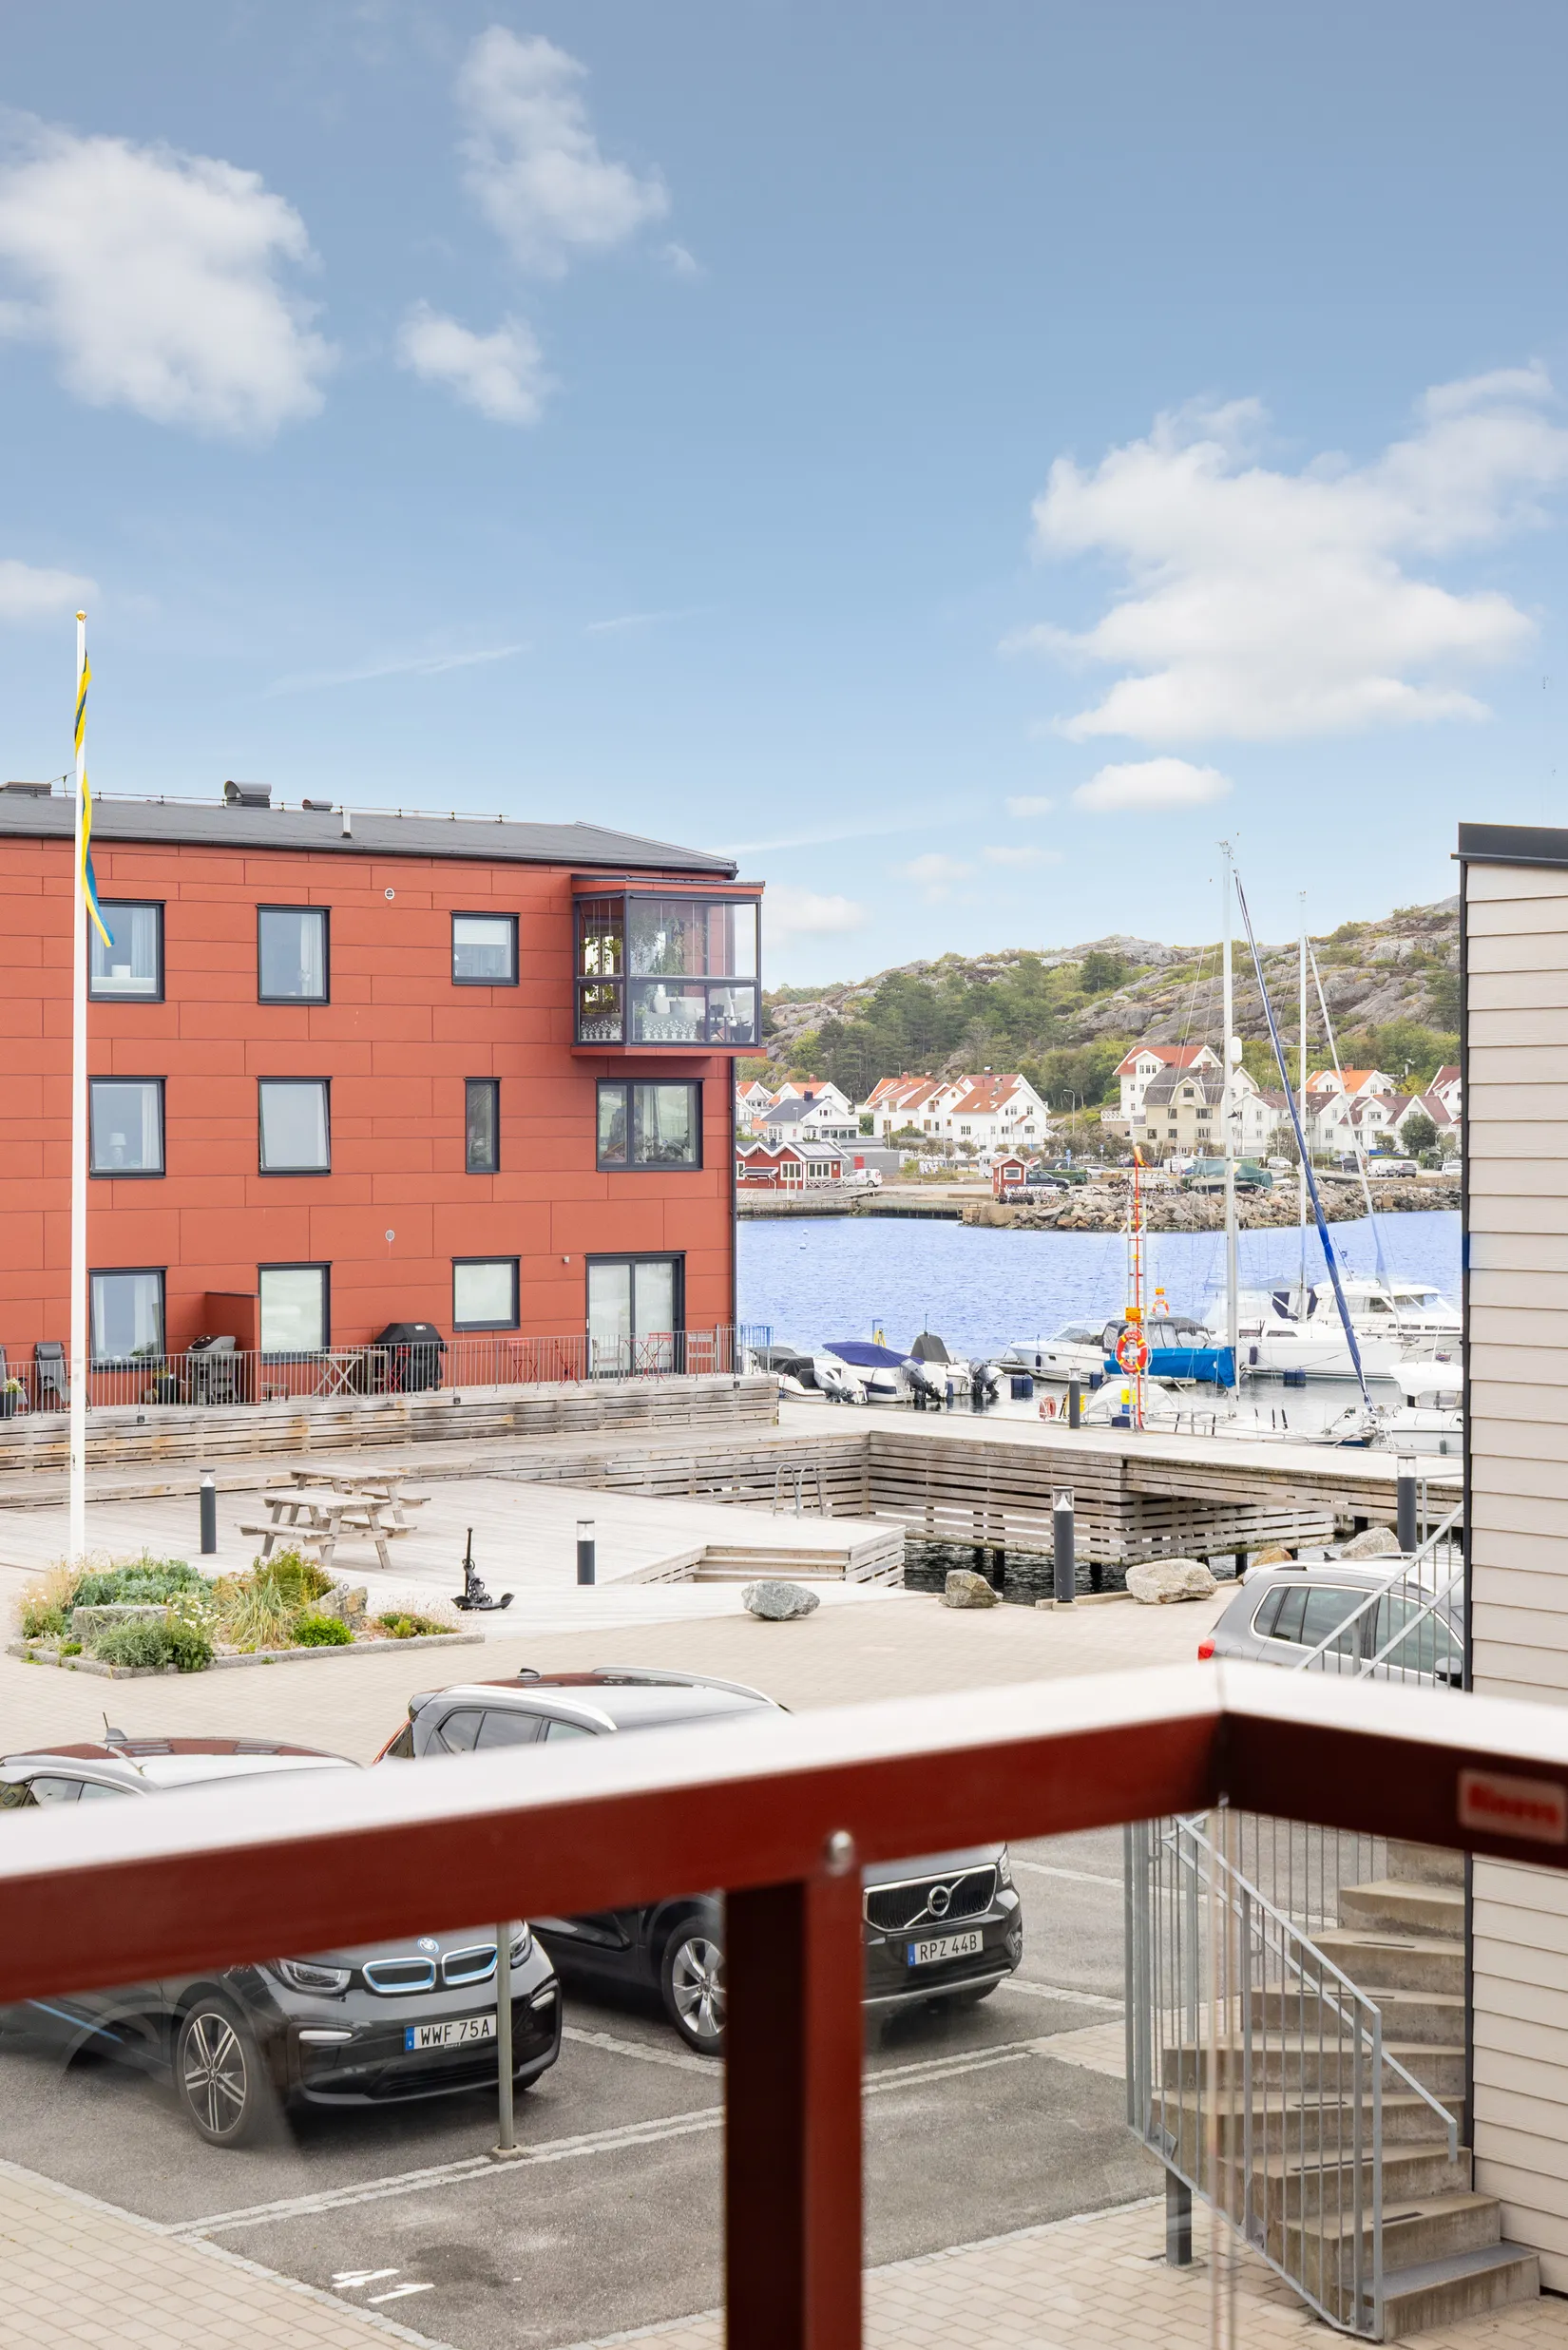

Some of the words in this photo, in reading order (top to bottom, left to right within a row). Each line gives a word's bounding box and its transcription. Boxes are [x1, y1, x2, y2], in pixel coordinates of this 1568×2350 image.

[920, 1940, 947, 1961] RPZ
[951, 1934, 977, 1954] 44B
[420, 2024, 452, 2045] WWF
[459, 2018, 490, 2040] 75A
